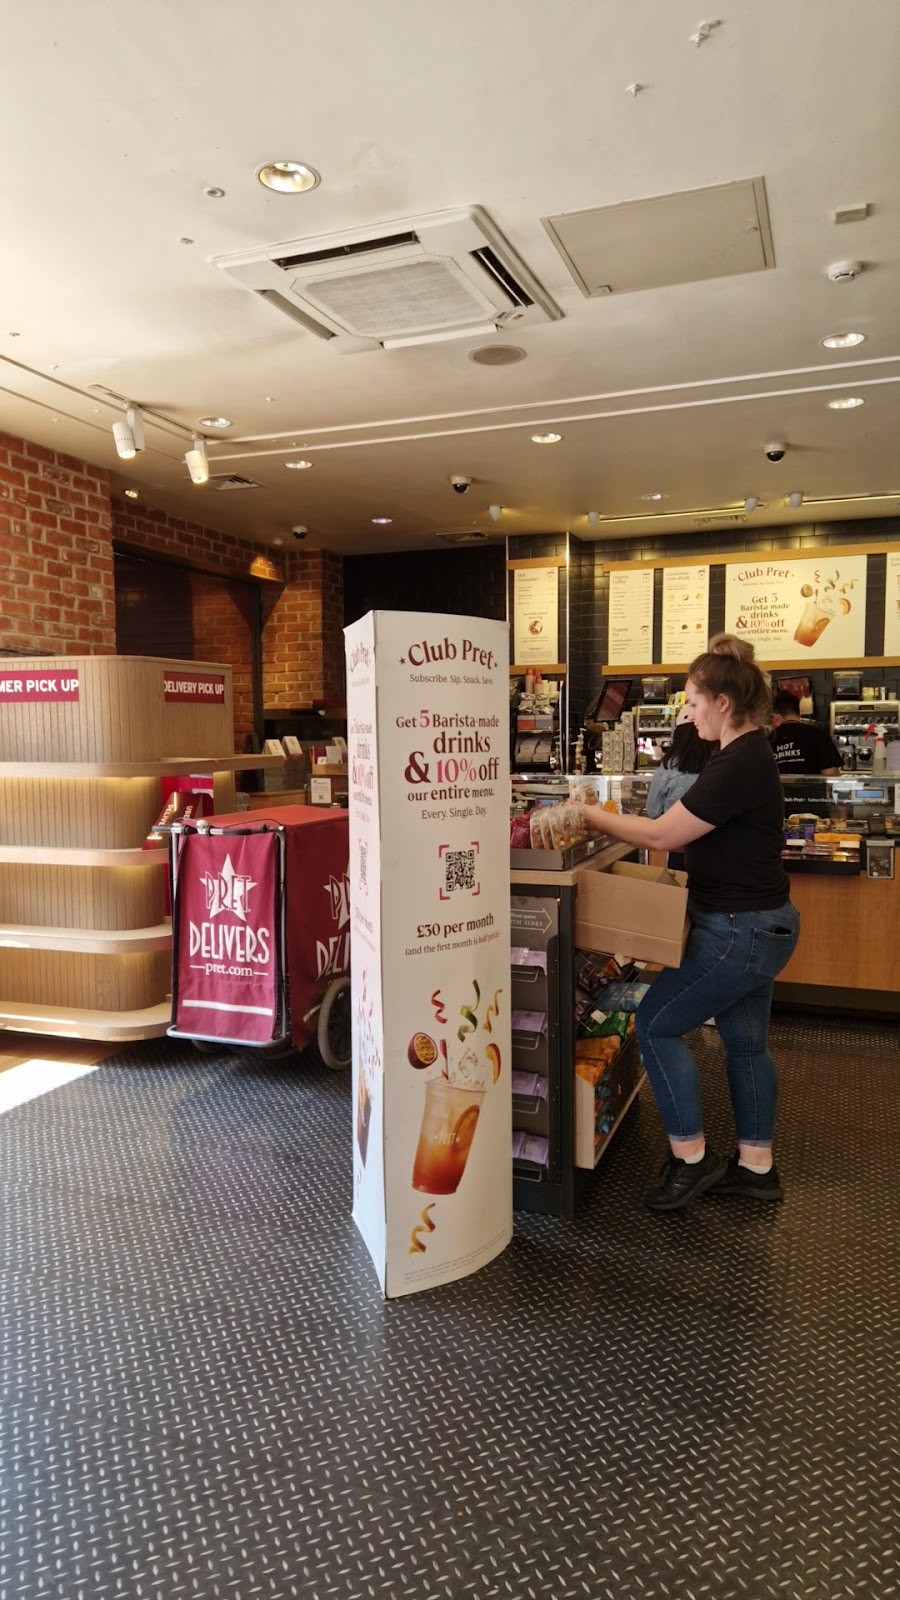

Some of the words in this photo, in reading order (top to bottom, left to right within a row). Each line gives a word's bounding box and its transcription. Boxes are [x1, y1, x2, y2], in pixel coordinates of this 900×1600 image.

[738, 567, 763, 582] Club
[766, 567, 790, 579] Pret
[752, 595, 768, 604] Get
[771, 592, 778, 602] 5
[750, 610, 779, 619] drinks
[736, 616, 748, 629] &
[771, 618, 785, 627] off
[748, 627, 770, 635] entire
[408, 637, 457, 667] Club
[462, 638, 494, 670] Pret
[26, 679, 58, 692] PICK
[60, 678, 80, 692] UP
[410, 673, 449, 684] Subscribe.
[450, 674, 462, 684] Sip.
[463, 676, 481, 684] Snack.
[482, 676, 494, 685] Save.
[164, 680, 198, 694] DELIVERY
[198, 682, 214, 695] PICK
[214, 684, 224, 695] UP
[396, 715, 417, 728] Get
[420, 709, 430, 729] 5
[433, 731, 491, 754] drinks
[776, 742, 794, 752] HOT
[404, 750, 431, 785] &
[436, 758, 477, 784] 10%
[478, 756, 500, 781] off
[407, 790, 430, 802] our
[430, 785, 471, 801] entire
[472, 786, 495, 798] menu.
[422, 809, 448, 820] Every.
[449, 806, 475, 820] Single.
[475, 806, 488, 817] Day.
[204, 870, 252, 913] PRET
[416, 922, 440, 939] £30
[444, 922, 464, 938] per
[466, 912, 494, 932] month
[190, 921, 270, 964] DELIVERS
[405, 946, 422, 957] (and
[424, 944, 436, 954] the
[436, 943, 451, 952] first
[452, 938, 473, 949] month
[204, 962, 253, 977] pret.com
